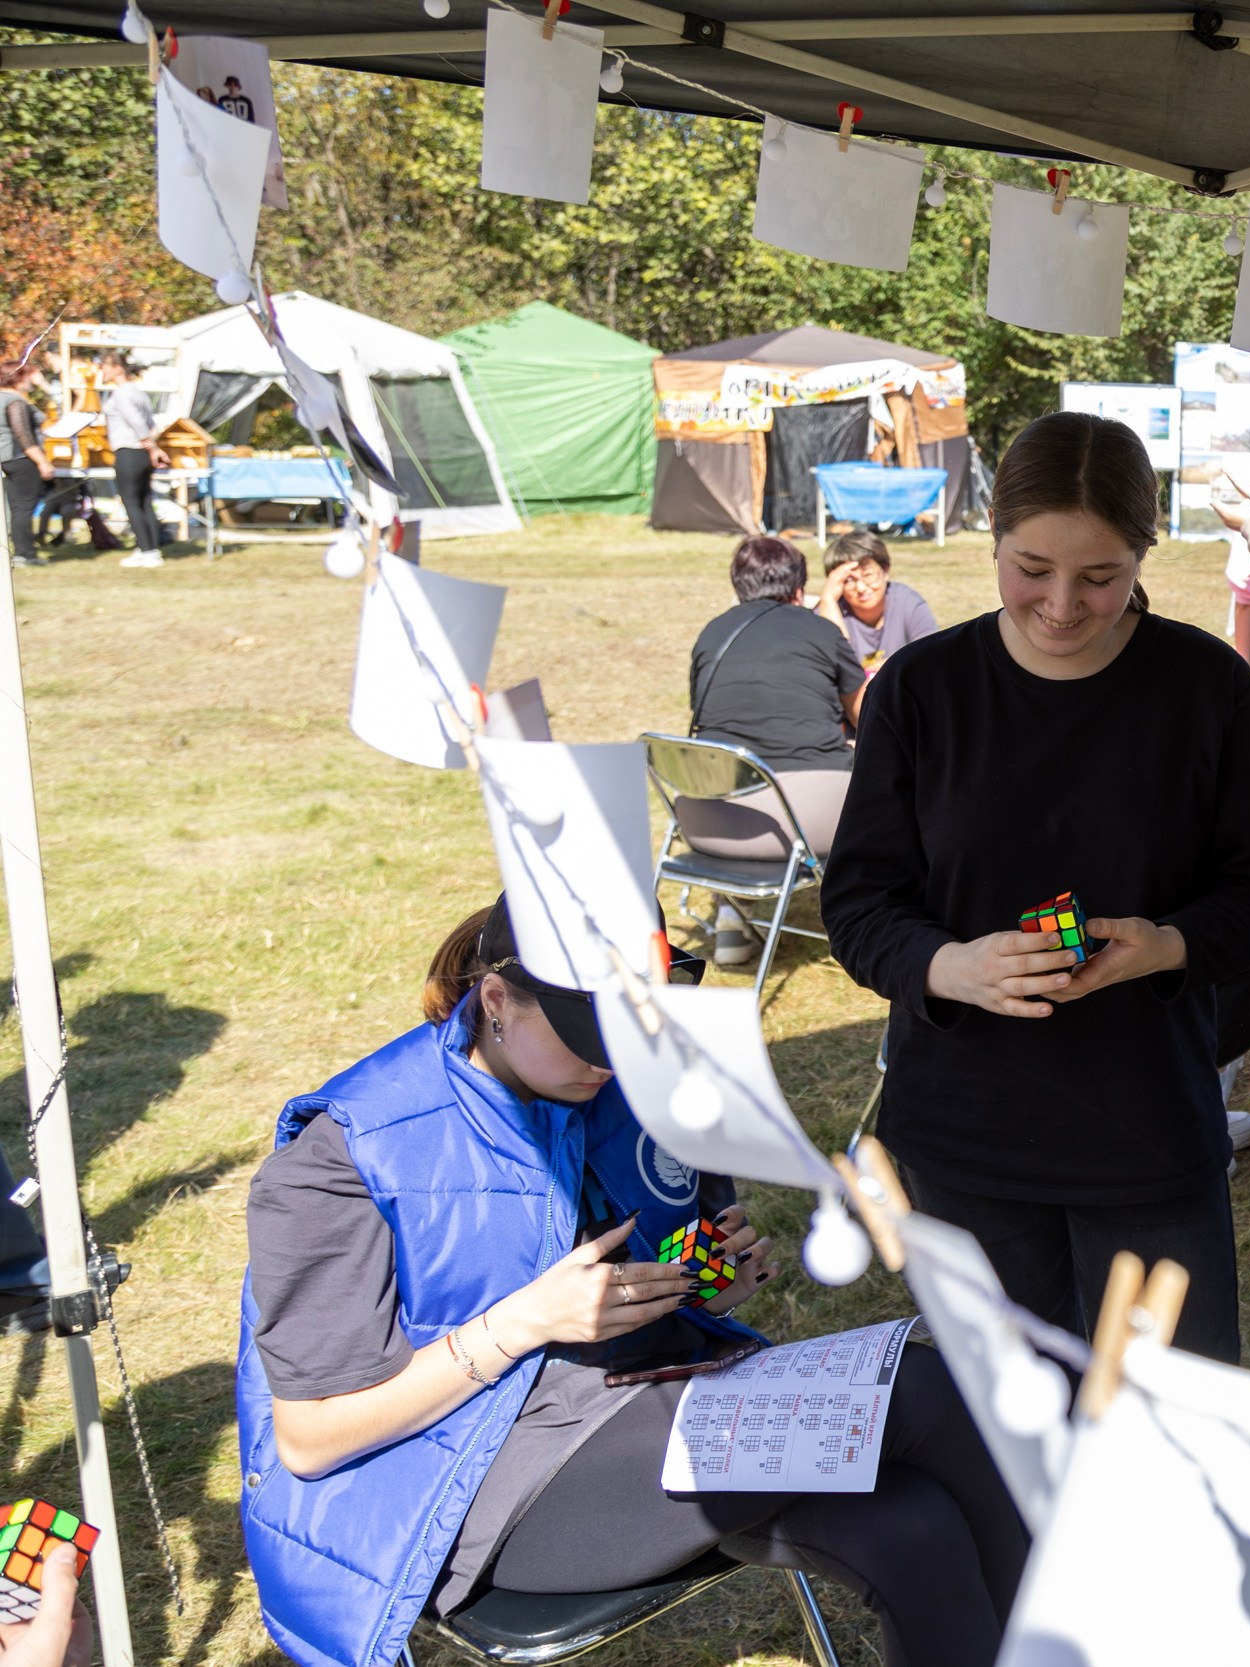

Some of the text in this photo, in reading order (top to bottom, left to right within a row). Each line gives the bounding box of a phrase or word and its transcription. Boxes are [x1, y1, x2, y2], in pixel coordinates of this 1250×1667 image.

[883, 1325, 906, 1368] ФОРМУЛЫ
[792, 1394, 802, 1417] РЫБКА
[866, 1424, 875, 1446] КРЕСТ
[723, 1445, 733, 1473] УГОЛКИ
